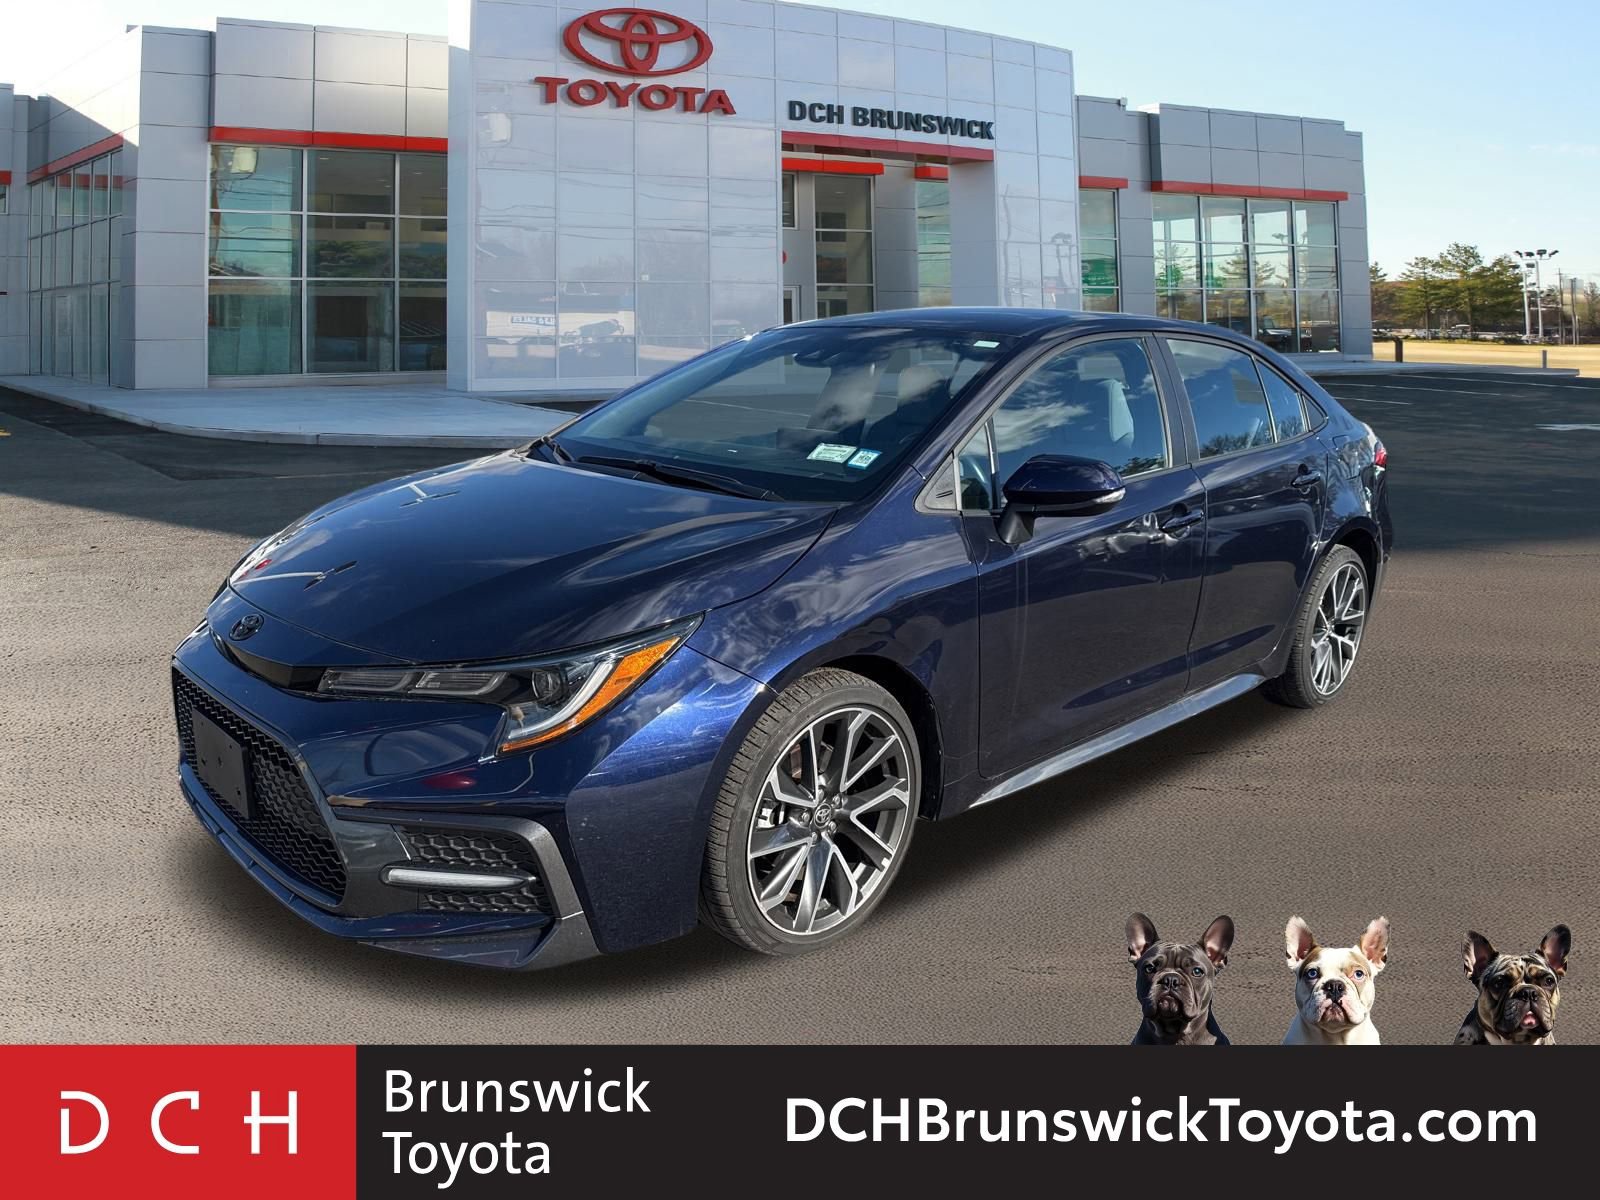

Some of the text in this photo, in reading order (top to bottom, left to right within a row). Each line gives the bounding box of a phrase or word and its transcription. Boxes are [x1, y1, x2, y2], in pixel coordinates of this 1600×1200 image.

[534, 76, 737, 116] TOYOTA
[788, 100, 995, 141] DCH BRUNSWICK
